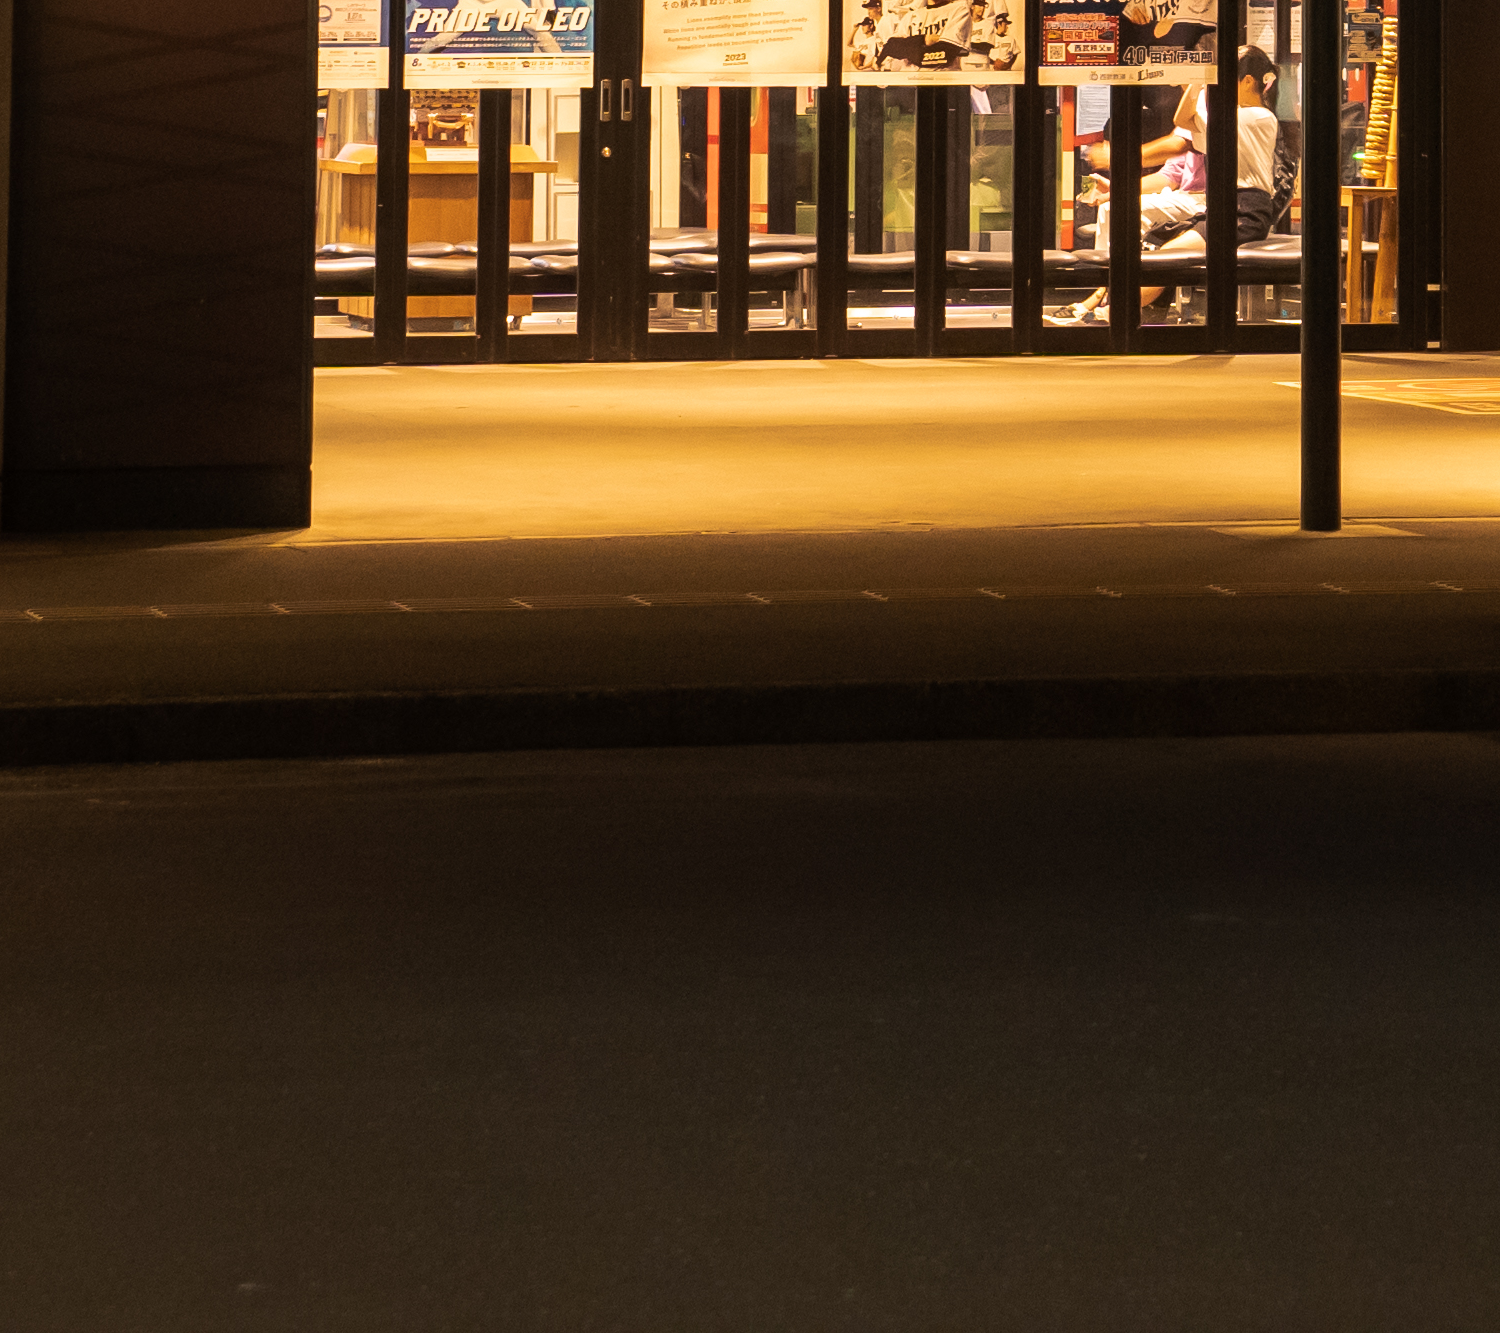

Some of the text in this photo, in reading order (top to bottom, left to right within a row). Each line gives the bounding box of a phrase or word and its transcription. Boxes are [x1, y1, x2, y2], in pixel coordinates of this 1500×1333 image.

[407, 6, 591, 33] PRIDE OF LEO
[724, 53, 747, 62] 2023
[923, 51, 946, 61] 2023
[1123, 45, 1148, 65] 40
